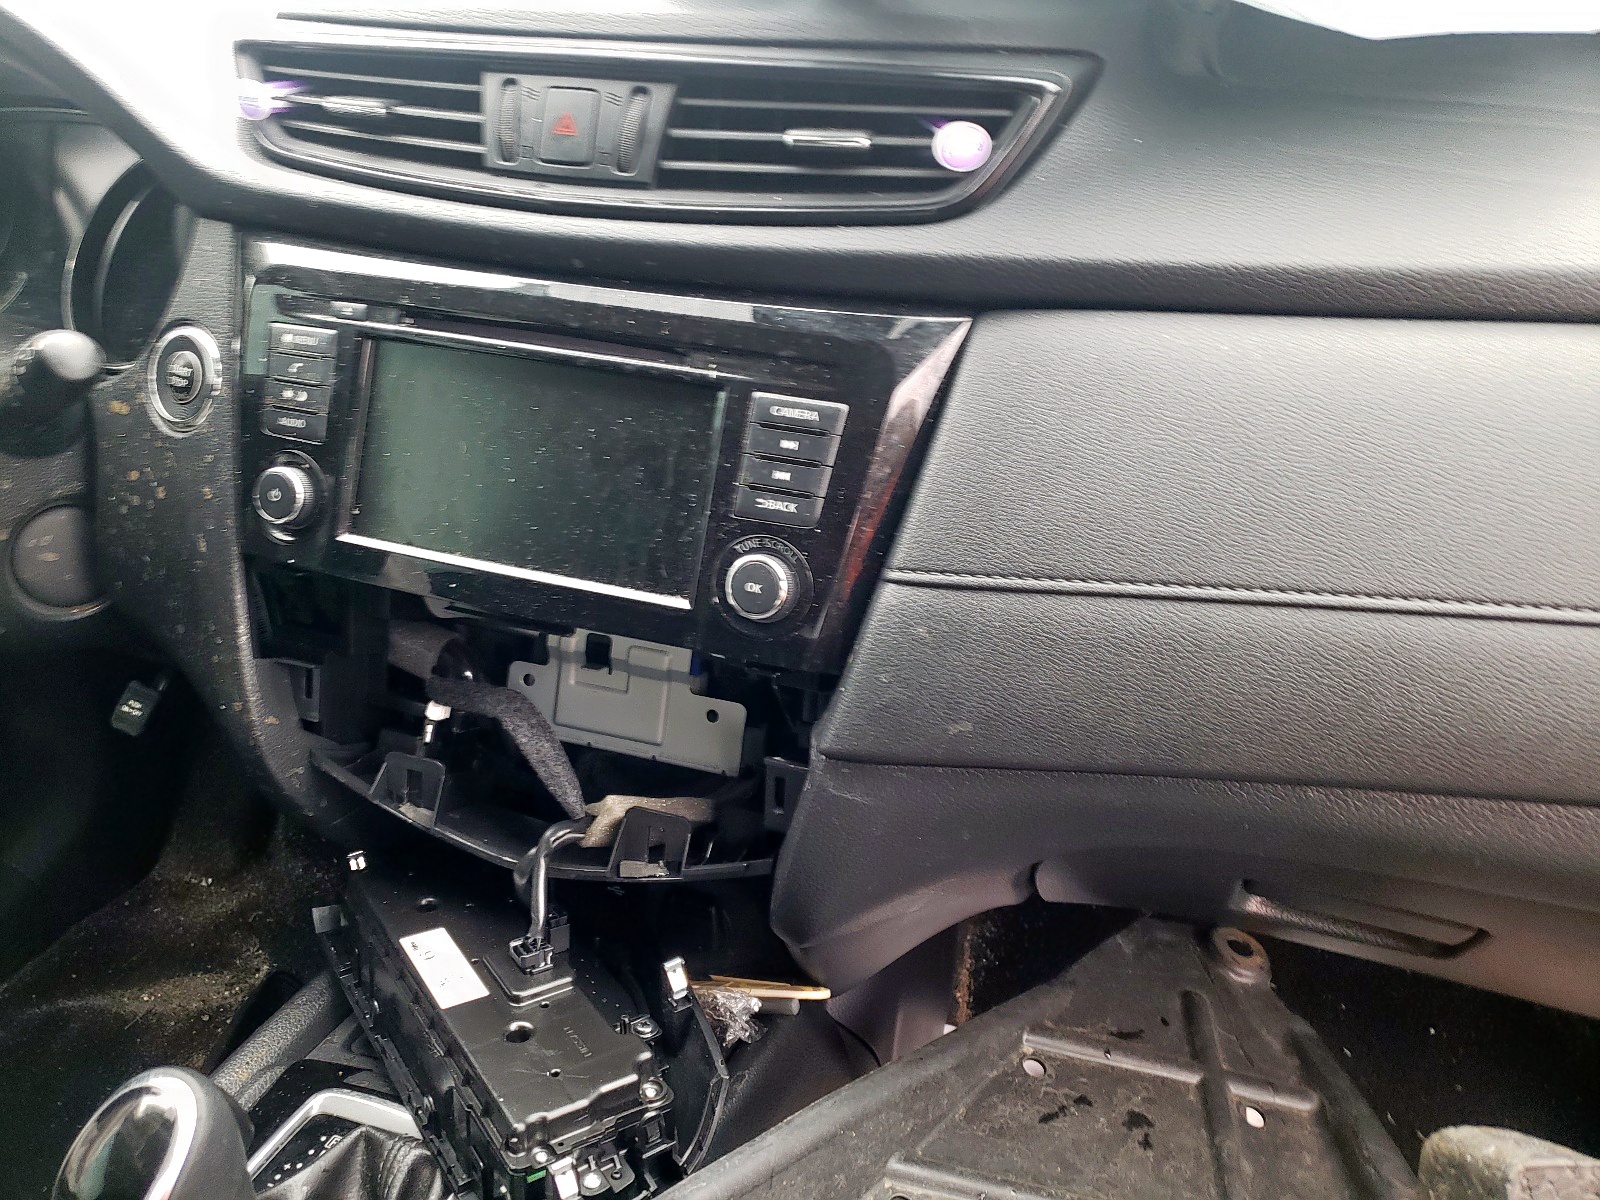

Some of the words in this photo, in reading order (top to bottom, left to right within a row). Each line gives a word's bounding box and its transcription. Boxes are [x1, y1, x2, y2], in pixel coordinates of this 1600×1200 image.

[770, 405, 820, 422] CAMERA
[277, 416, 307, 428] AUDIO
[768, 500, 799, 514] BACK
[744, 581, 763, 594] OK
